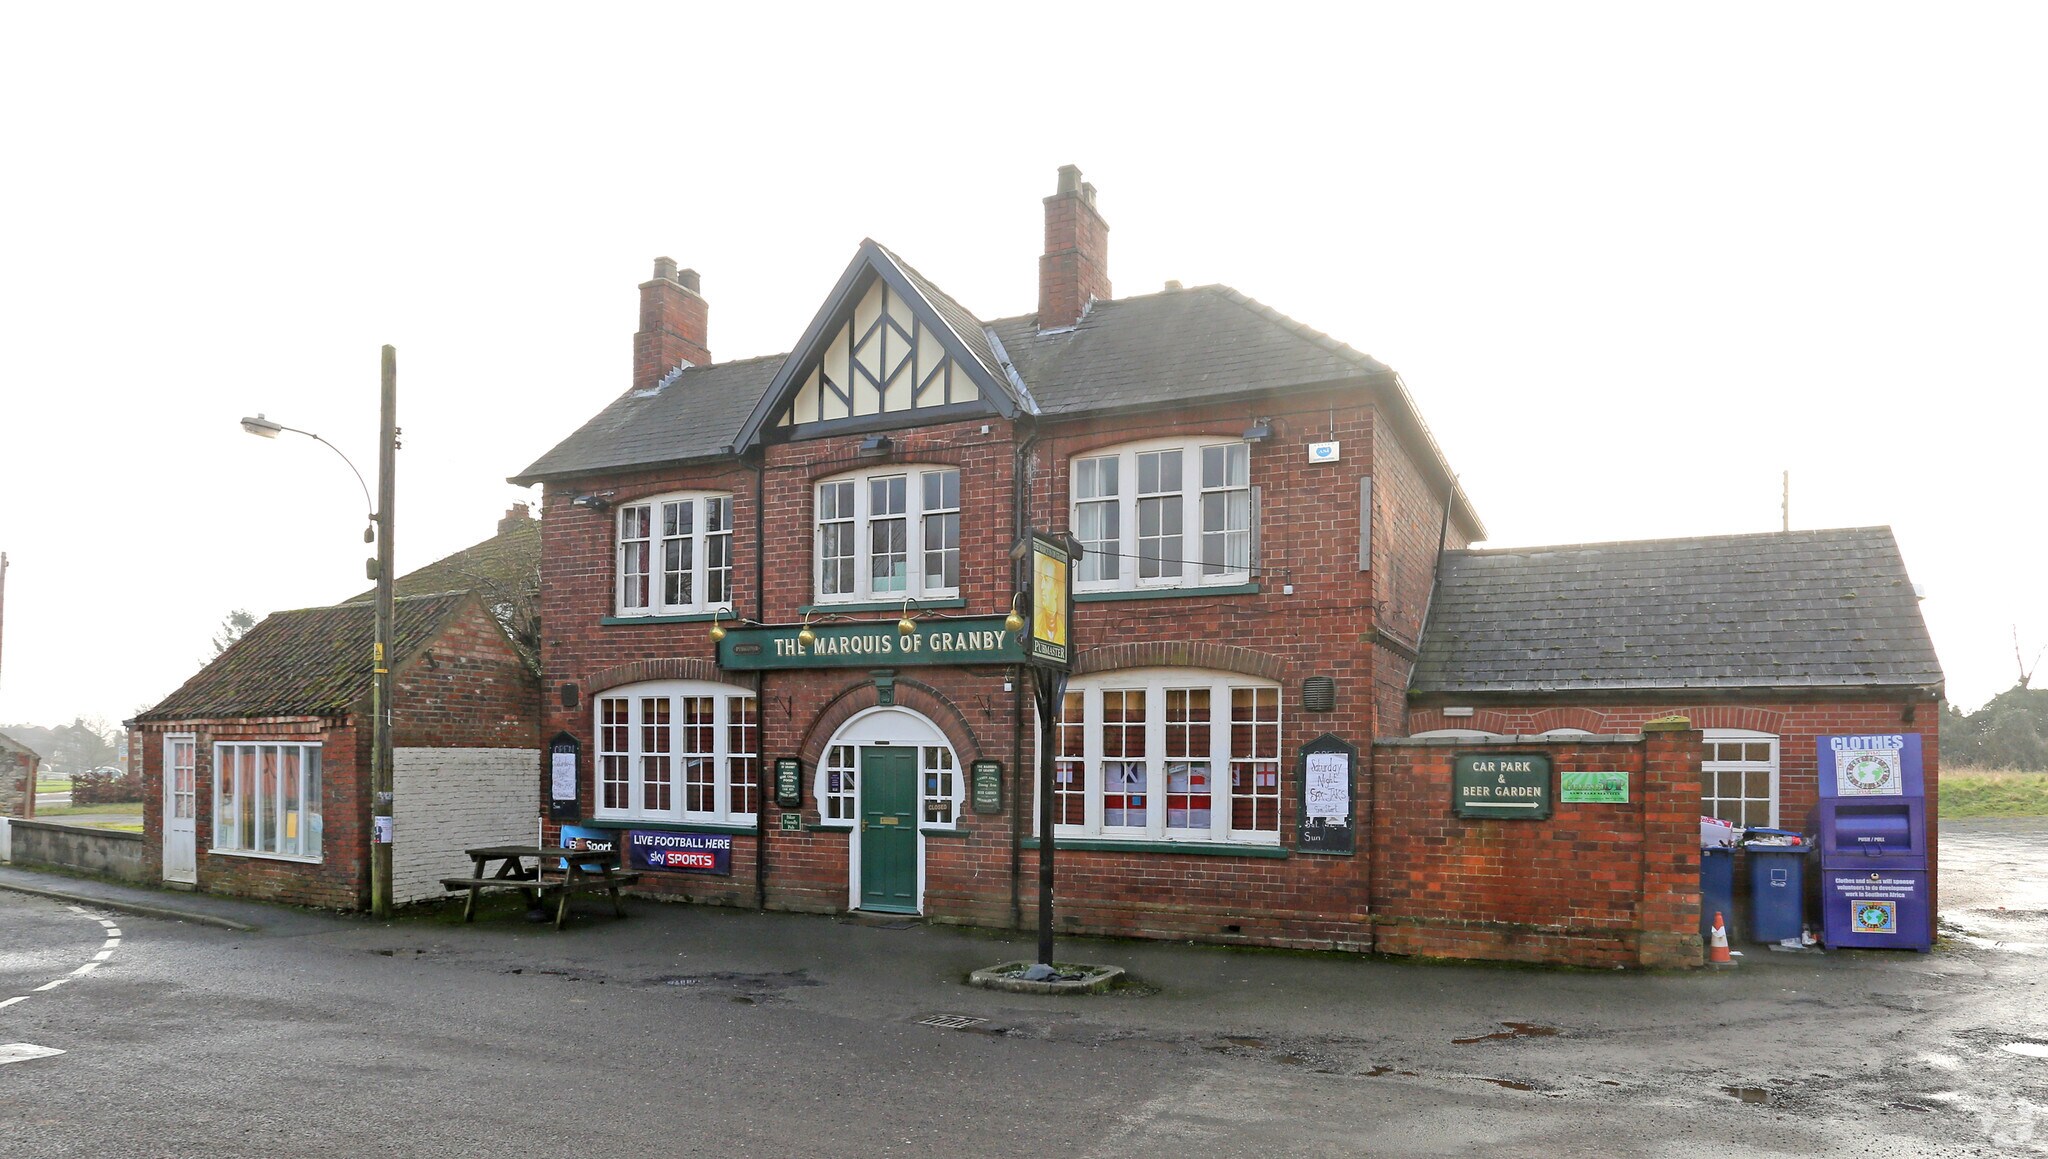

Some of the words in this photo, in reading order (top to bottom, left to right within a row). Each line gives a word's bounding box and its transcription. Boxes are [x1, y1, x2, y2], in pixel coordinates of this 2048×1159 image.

[774, 638, 806, 656] THE
[814, 635, 892, 655] MARQUIS
[900, 633, 922, 653] OF
[930, 630, 1006, 651] GRANBY
[1034, 640, 1065, 659] PUBMASTER
[1830, 735, 1904, 751] CLOTHES
[1311, 758, 1342, 776] Saturday
[1472, 761, 1495, 772] CAR
[1500, 761, 1531, 772] PARK
[1318, 773, 1338, 788] Night
[1497, 774, 1506, 784] &
[1463, 786, 1490, 796] BEER
[1495, 786, 1541, 797] GARDEN
[634, 835, 653, 845] LIVE
[654, 836, 704, 848] FOOTBALL
[705, 838, 730, 849] HERE
[1304, 832, 1321, 841] Sun
[586, 840, 612, 850] Sport
[650, 851, 666, 864] sky
[667, 853, 713, 866] SPORTS
